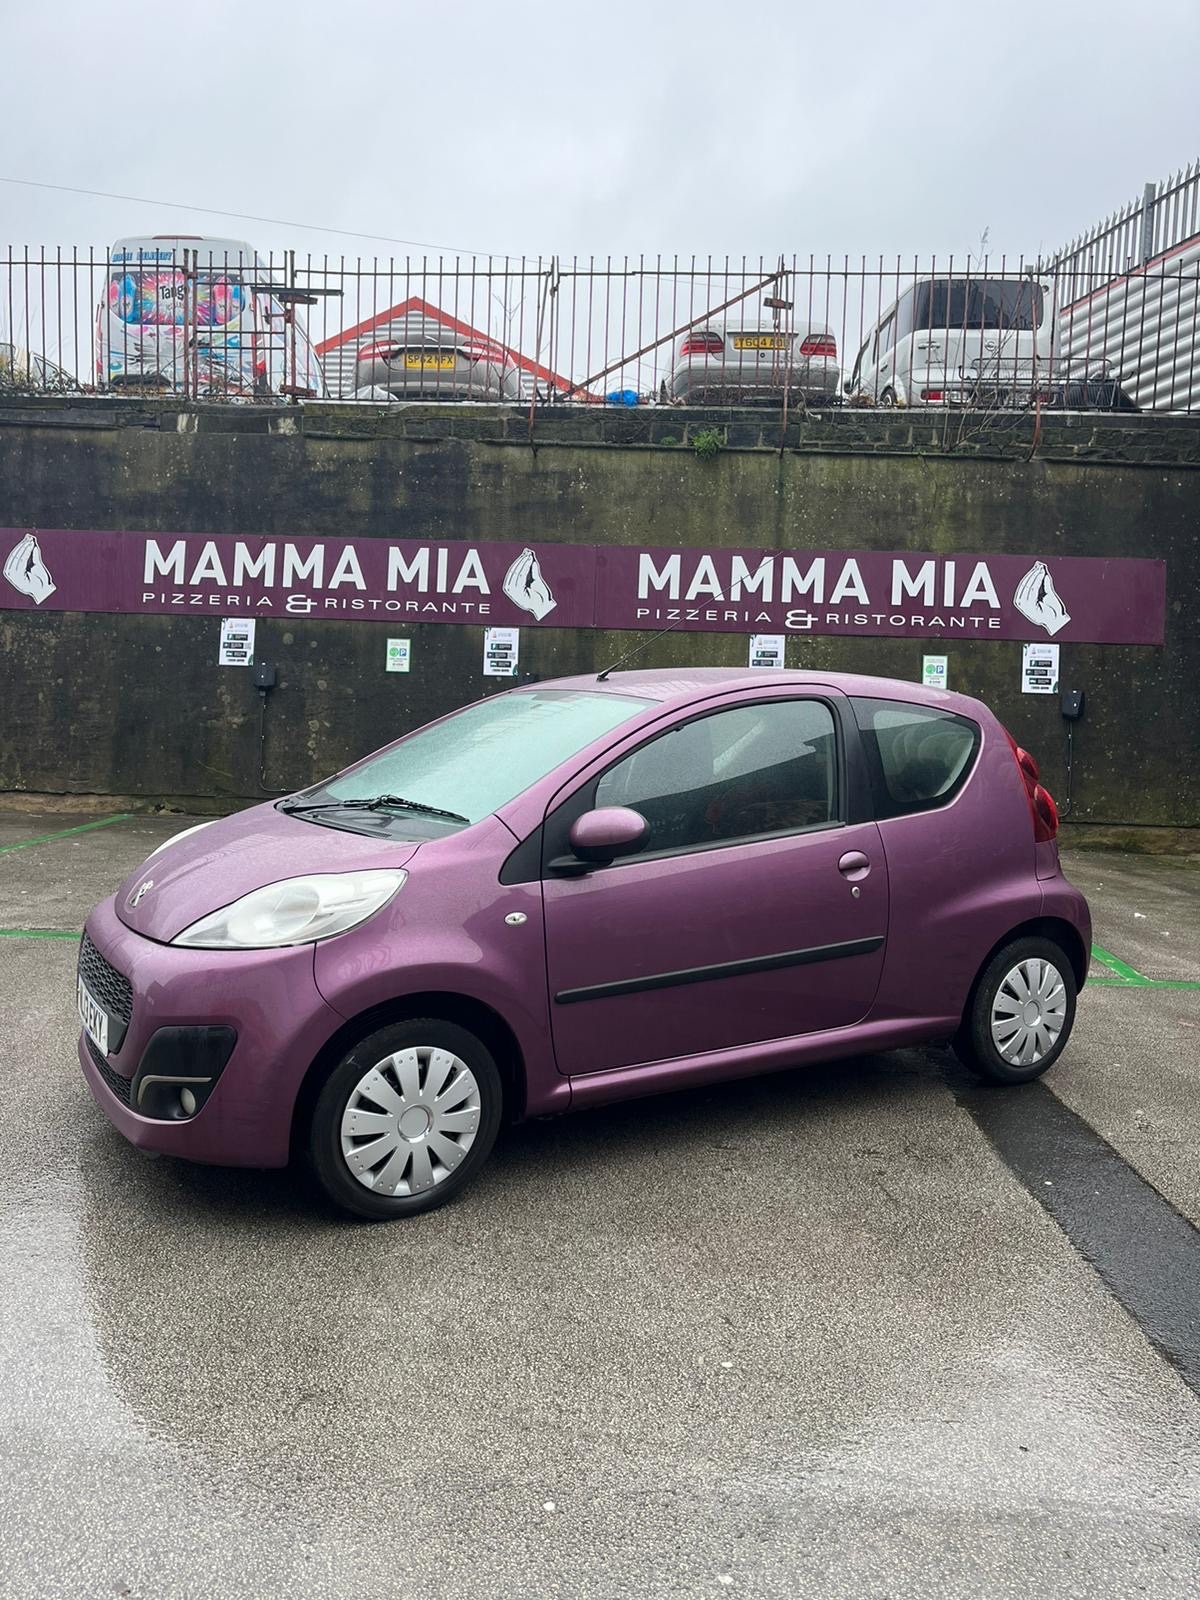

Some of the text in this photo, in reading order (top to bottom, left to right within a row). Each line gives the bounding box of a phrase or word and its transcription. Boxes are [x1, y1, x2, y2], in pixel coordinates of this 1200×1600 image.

[143, 539, 491, 594] MAMMA MIA
[637, 553, 1000, 609] MAMMA MIA
[142, 592, 273, 607] PIZZERIA
[324, 598, 491, 614] RISTORANTE
[636, 608, 772, 623] PIZZERIA
[826, 613, 1001, 629] RISTORANTE
